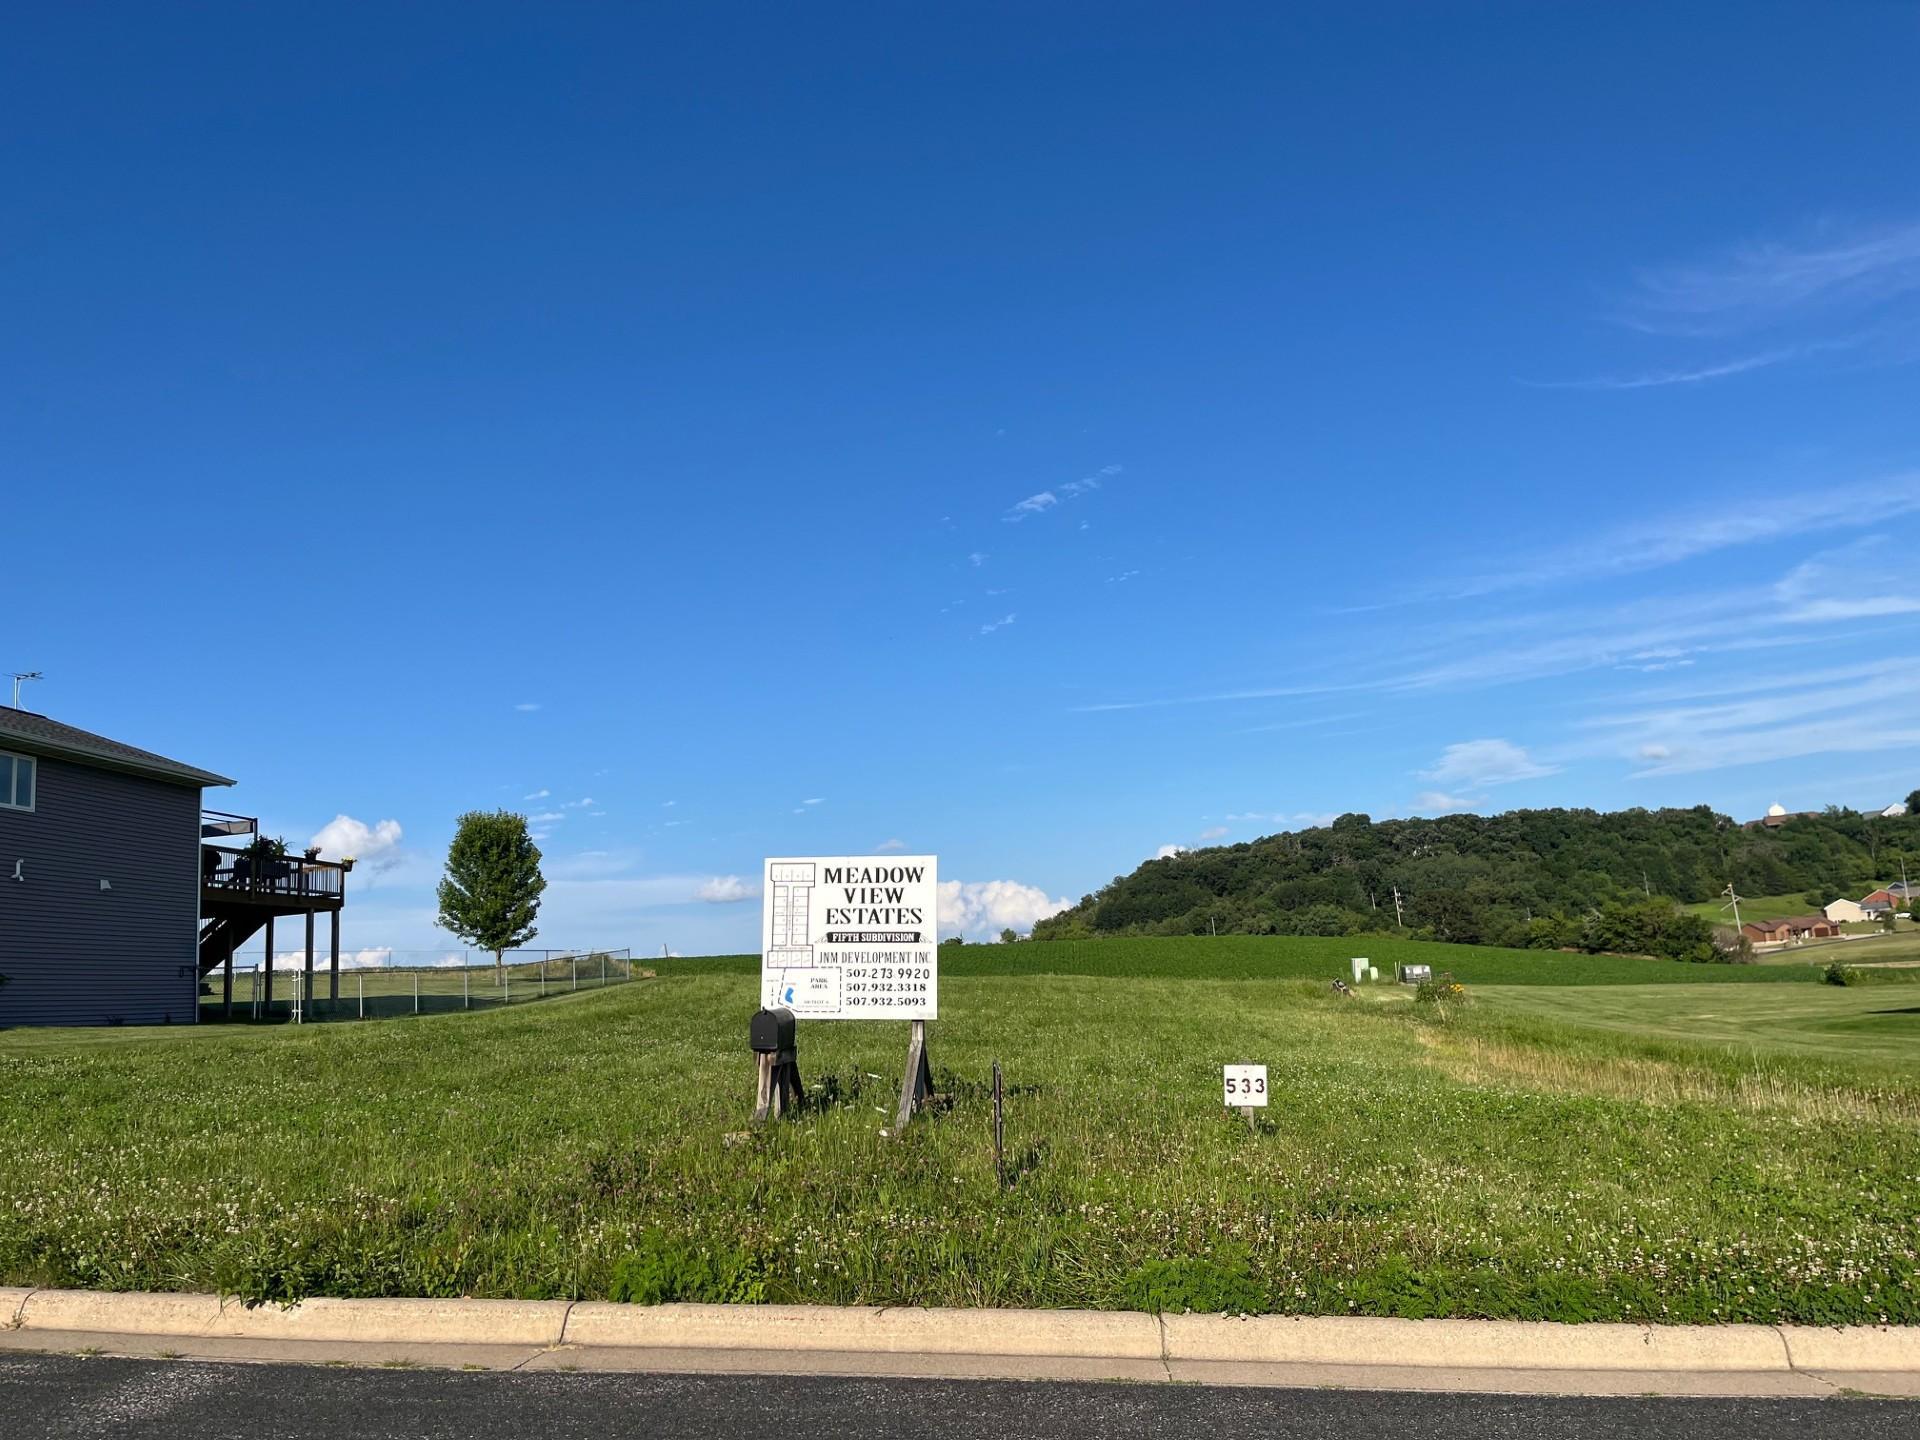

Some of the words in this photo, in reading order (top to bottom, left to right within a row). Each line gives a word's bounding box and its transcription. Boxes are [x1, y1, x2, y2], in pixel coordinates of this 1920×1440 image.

[824, 866, 924, 884] MEADOW
[844, 887, 904, 904] VIEW
[825, 907, 923, 925] ESTATES
[832, 933, 859, 942] FIFTH
[861, 933, 915, 942] SUBDIVISION
[818, 951, 838, 964] JNM
[841, 951, 912, 964] DEVELOPMENT
[846, 983, 927, 992] 507.932.3318
[846, 997, 926, 1006] 507.932.5093
[1226, 1078, 1265, 1094] 533
